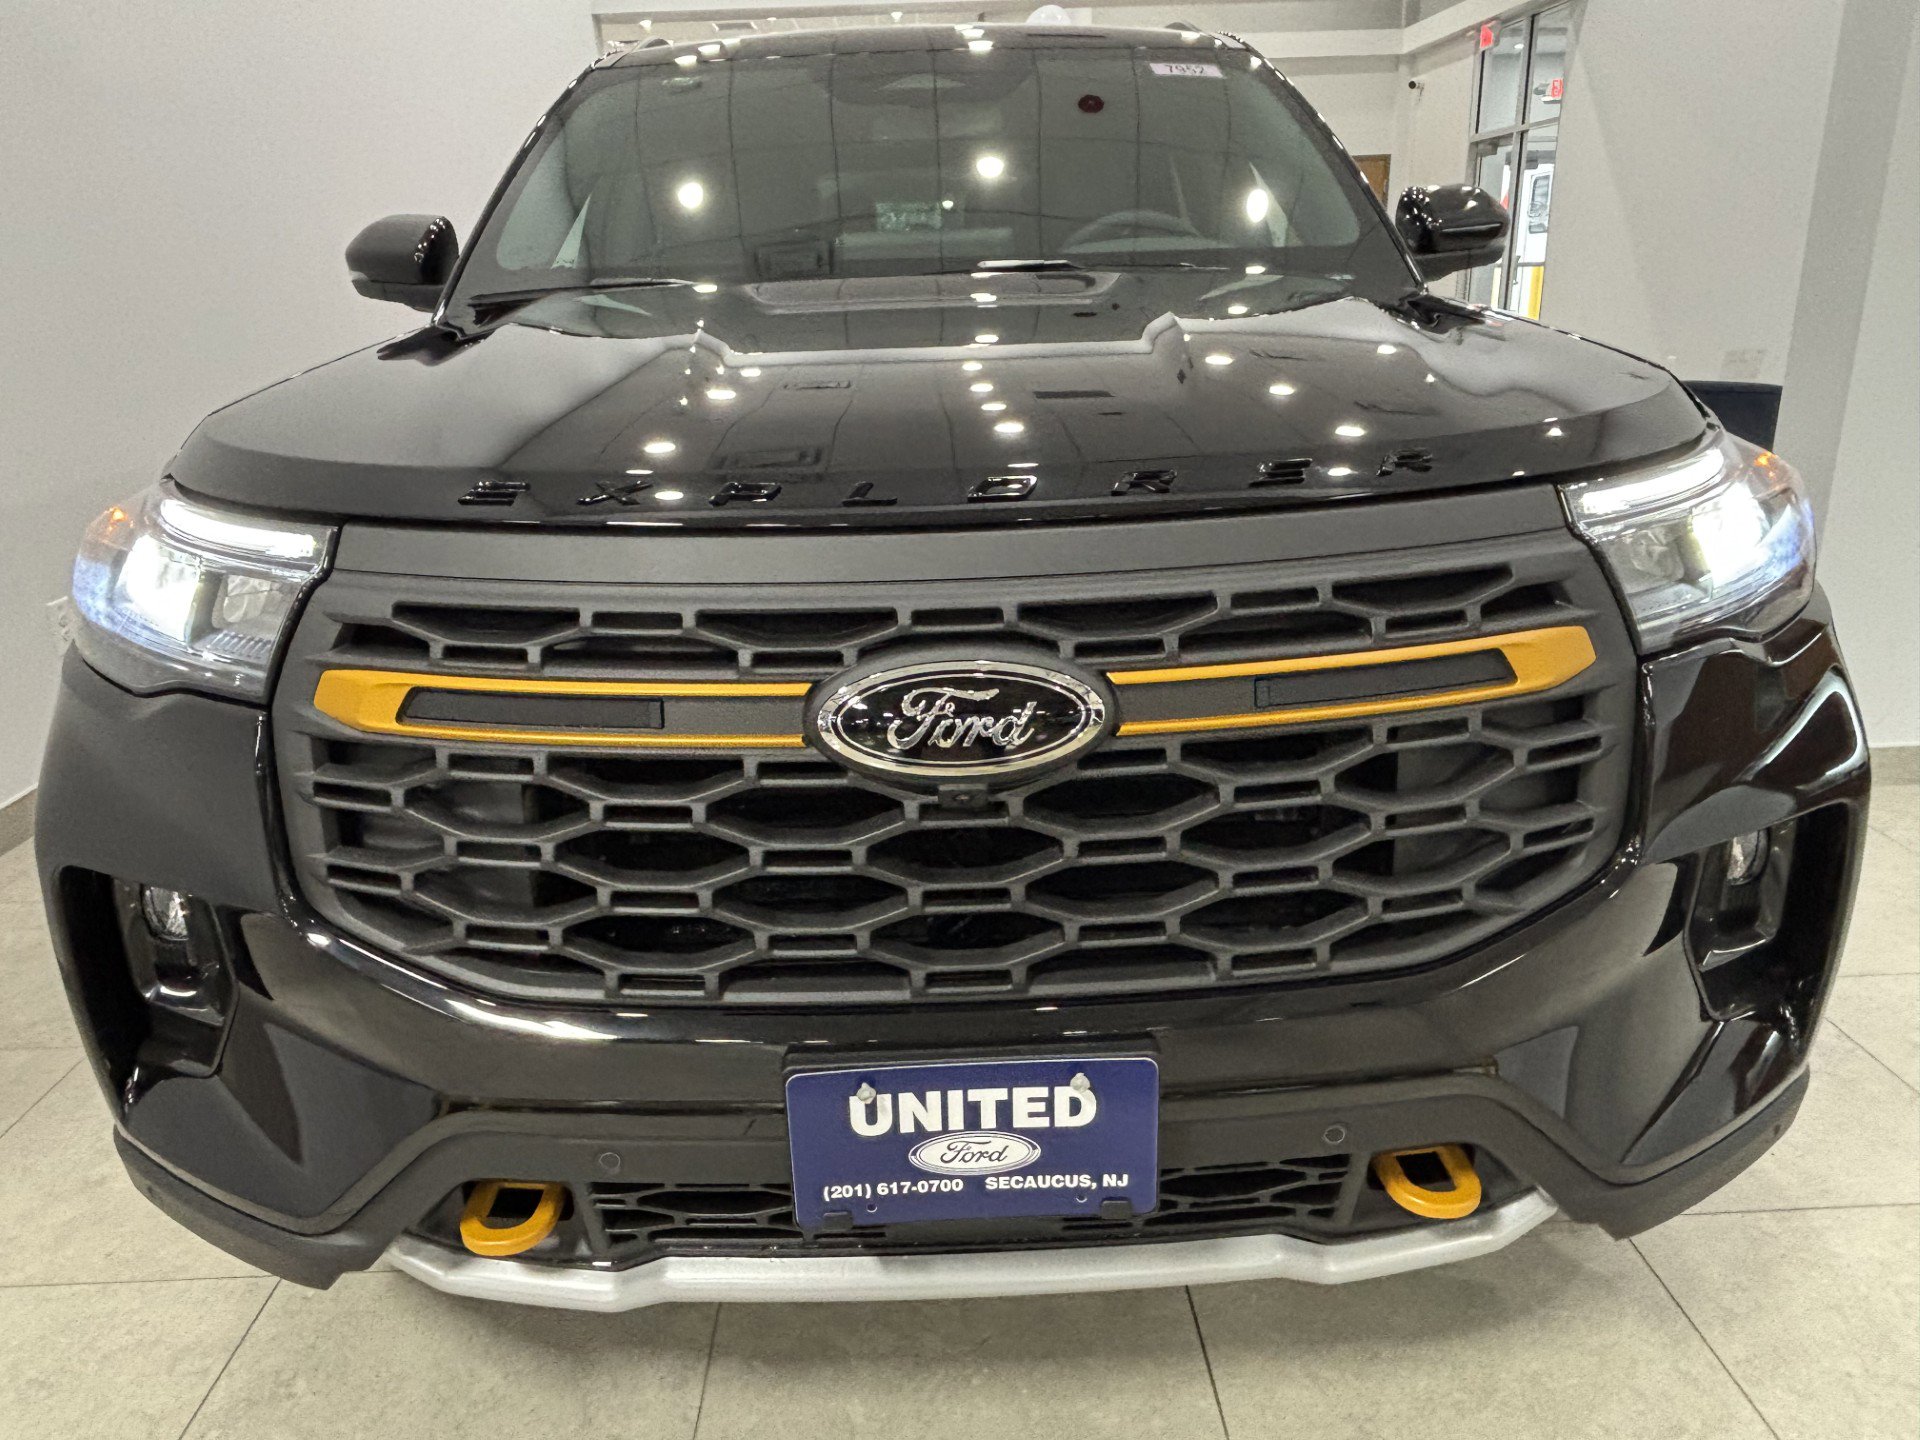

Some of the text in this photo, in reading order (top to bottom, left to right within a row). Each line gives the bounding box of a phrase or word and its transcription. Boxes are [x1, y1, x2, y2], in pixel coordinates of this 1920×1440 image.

[457, 446, 1433, 507] EXPLORER
[886, 687, 1038, 750] Ford
[848, 1085, 1097, 1137] UNITED
[939, 1139, 1009, 1164] Ford
[823, 1178, 964, 1202] (201) 617-0700
[984, 1173, 1129, 1191] SECAUCUS, NJ
